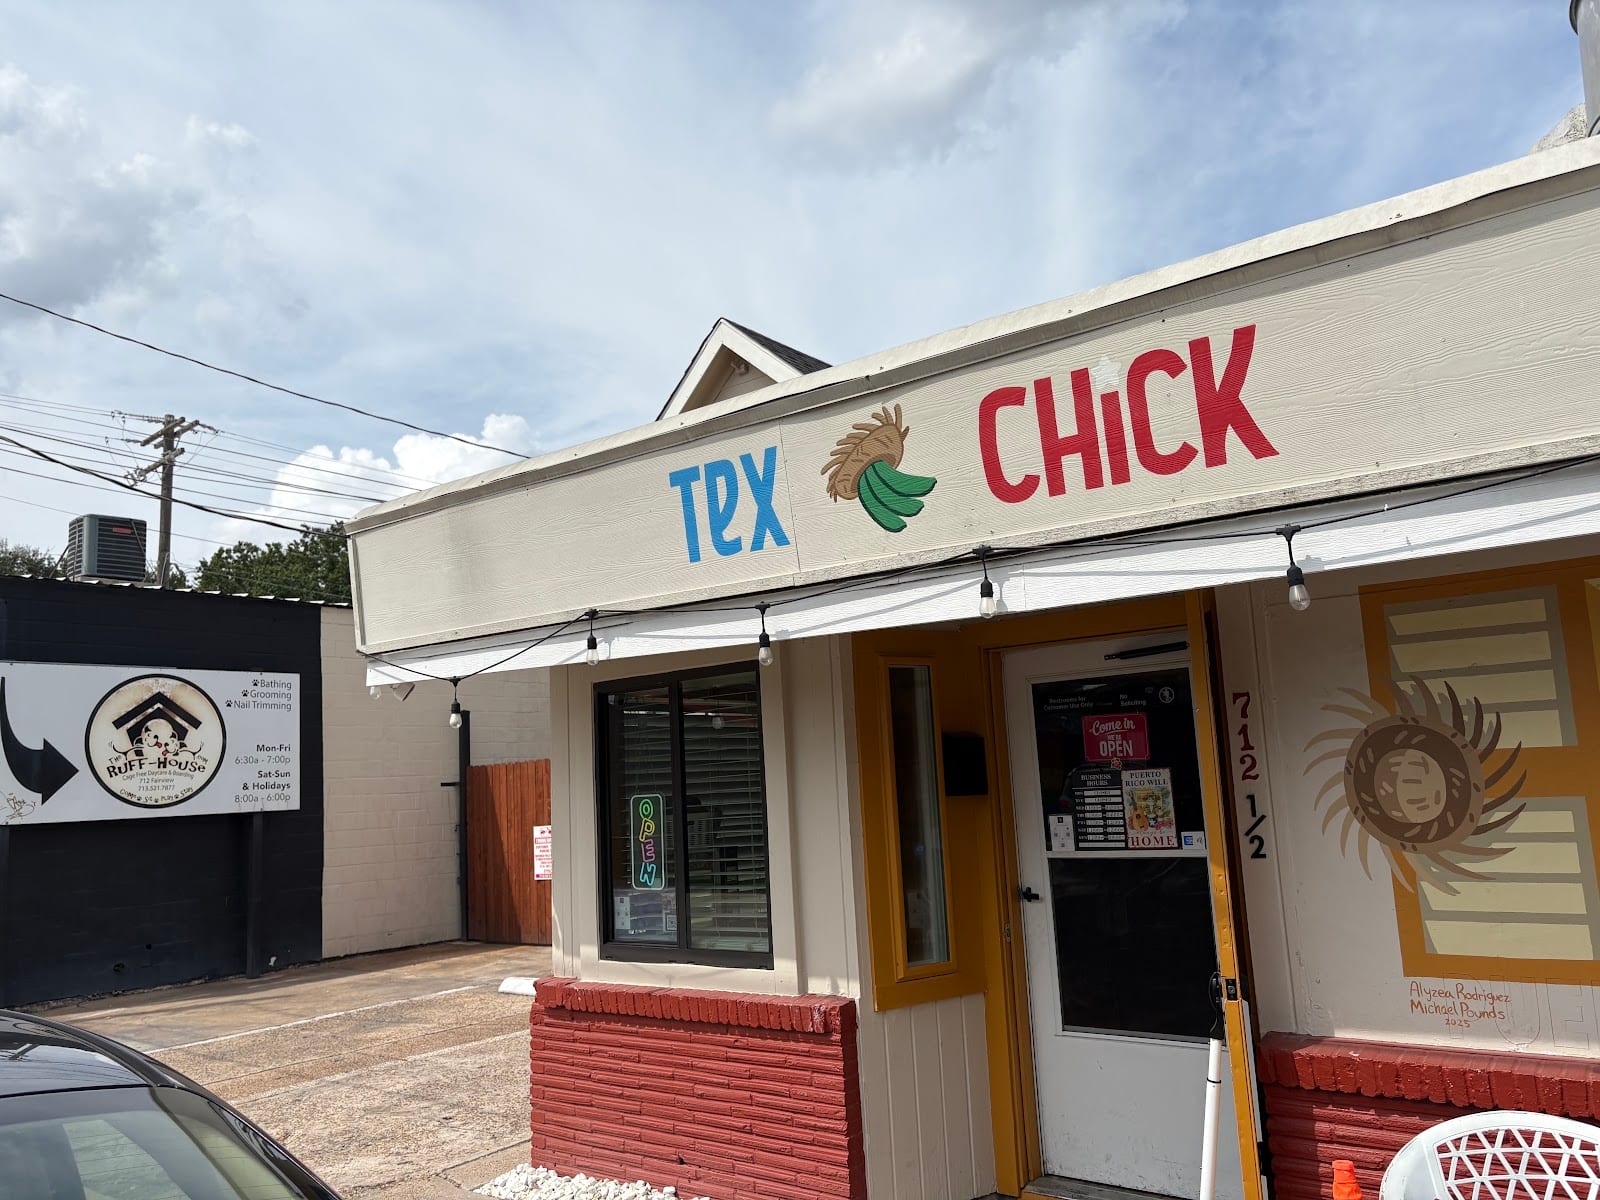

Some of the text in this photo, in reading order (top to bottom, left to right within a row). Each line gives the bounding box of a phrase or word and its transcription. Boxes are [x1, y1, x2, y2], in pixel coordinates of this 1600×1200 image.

[260, 679, 292, 690] Bathing
[250, 689, 292, 701] Grooming
[234, 700, 292, 712] Nail Trimming
[1088, 718, 1136, 736] Come in
[256, 744, 291, 752] Mon-Fri
[1099, 739, 1133, 757] OPEN
[234, 755, 259, 765] 6:30a
[266, 755, 291, 765] 7:00p
[257, 770, 291, 778] Sat-Sun
[1129, 771, 1162, 779] PUERTO
[242, 781, 291, 791] & Holidays
[234, 794, 259, 803] 8:00a
[266, 793, 291, 802] 6:00p
[639, 799, 657, 886] OPEN
[1128, 836, 1175, 847] HOME
[1408, 981, 1511, 1005] Alyzea Rodriguez
[1410, 999, 1506, 1019] Michael Pounds
[1444, 1018, 1471, 1028] 2025
